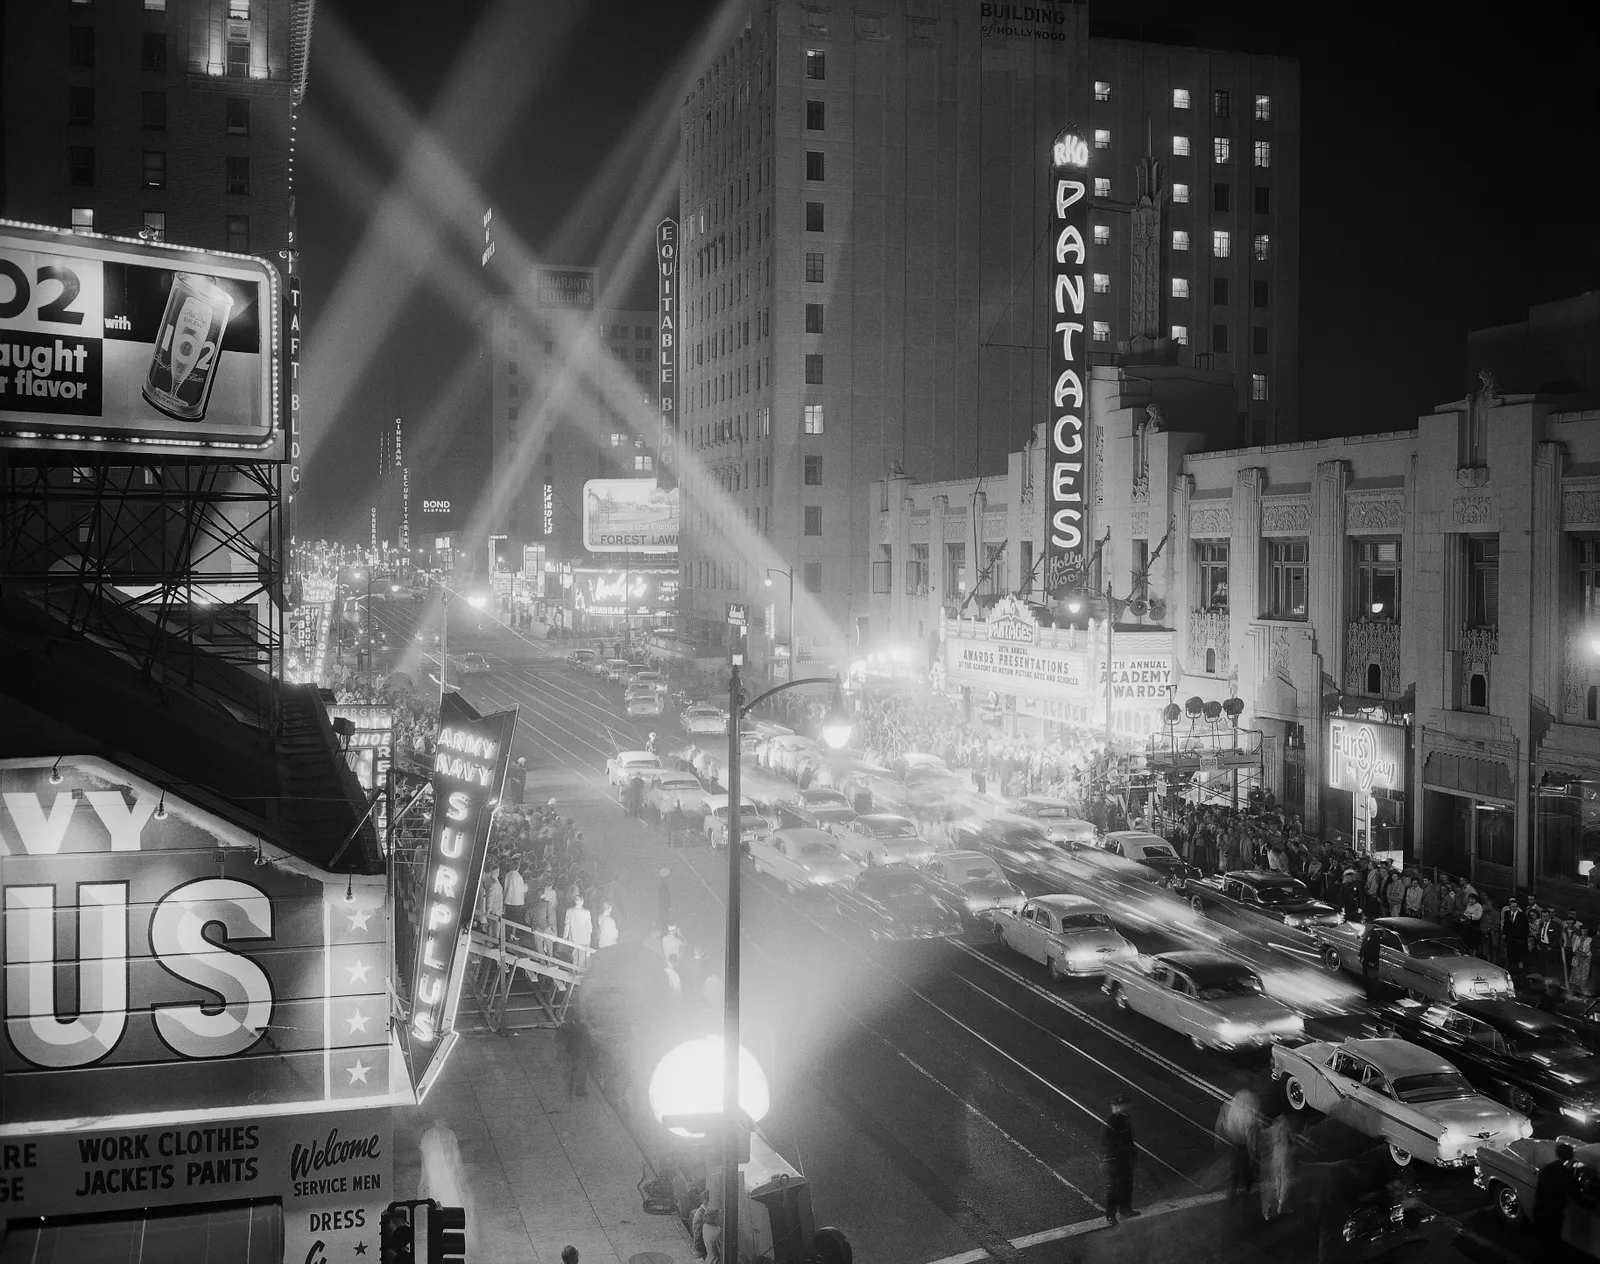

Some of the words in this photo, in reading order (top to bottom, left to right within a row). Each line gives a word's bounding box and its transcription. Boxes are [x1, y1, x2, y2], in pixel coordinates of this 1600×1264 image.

[981, 3, 1065, 24] BUILDING
[981, 24, 995, 37] of
[998, 26, 1066, 41] HOLLYWOOD
[1054, 134, 1088, 166] RKO
[661, 226, 673, 383] EQUITABLE
[104, 315, 132, 331] with
[290, 289, 300, 379] TAFT
[1051, 180, 1086, 548] PANTAGES
[15, 370, 88, 399] flavor
[290, 394, 300, 483] BLDG
[661, 397, 673, 464] BLDG
[423, 500, 451, 509] BOND
[600, 535, 646, 545] FOREST
[1050, 551, 1084, 574] Holly
[313, 603, 331, 681] STATIONERS
[990, 620, 1033, 641] PANTAGES
[963, 649, 994, 664] AWARDS
[999, 654, 1069, 674] PRESENTATIONS
[964, 661, 972, 669] THE
[973, 662, 991, 672] ACADEMY
[998, 667, 1014, 675] MOTION
[1015, 669, 1032, 679] PICTURE
[1034, 672, 1045, 681] ARTS
[1046, 674, 1056, 682] AND
[1057, 675, 1079, 686] SCIENCES
[1100, 661, 1125, 669] 2TH
[1130, 661, 1168, 669] ANNUAL
[1100, 670, 1171, 684] ACADEMY
[331, 708, 387, 717] MARGA'S
[349, 733, 392, 747] SHOE
[437, 727, 497, 759] ARMY
[1330, 724, 1365, 784] Furs
[435, 753, 493, 786] NAVY
[1346, 760, 1358, 780] by
[0, 792, 158, 855] VY
[412, 791, 468, 1043] SURPLUS
[4, 875, 276, 1069] US
[78, 1135, 148, 1163] WORK
[158, 1126, 260, 1156] CLOTHES
[290, 1128, 382, 1181] Welcome
[75, 1164, 175, 1197] JACKETS
[186, 1157, 260, 1186] PANTS
[293, 1177, 347, 1197] SERVICE
[352, 1174, 381, 1191] MEN
[310, 1208, 366, 1232] DRESS
